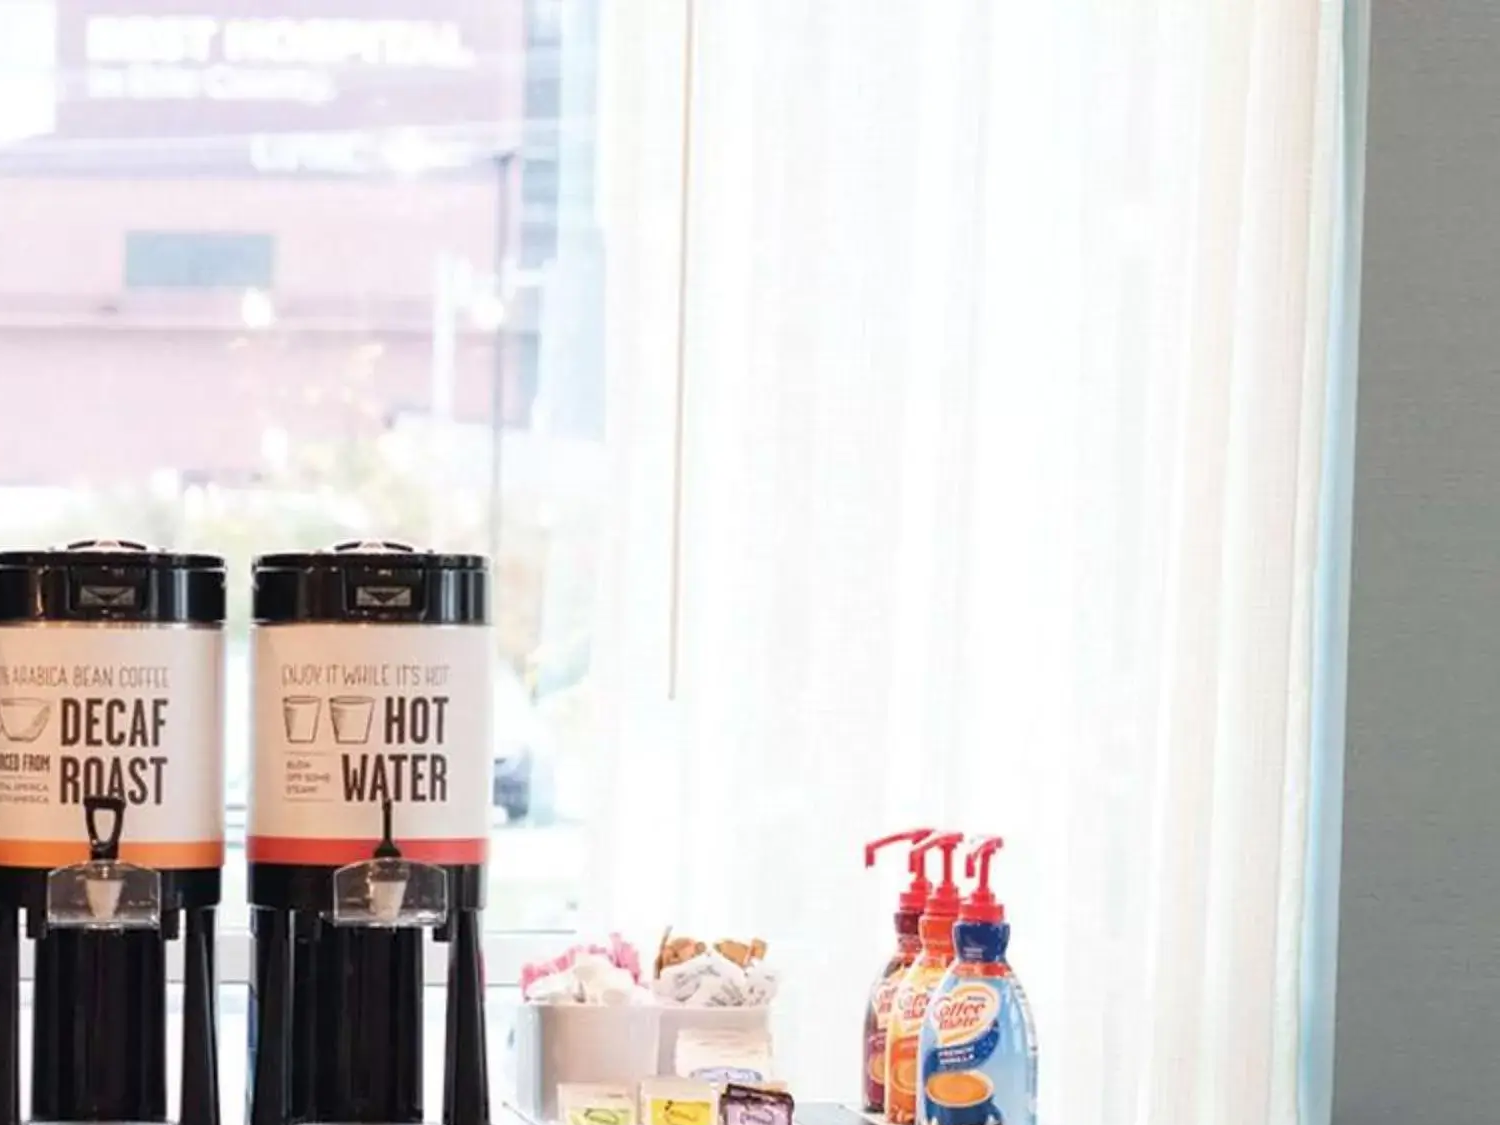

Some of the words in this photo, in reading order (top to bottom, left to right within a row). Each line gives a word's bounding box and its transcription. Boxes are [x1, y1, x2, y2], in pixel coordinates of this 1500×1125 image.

[12, 665, 68, 687] ARABICA
[73, 665, 113, 688] BEAN
[119, 667, 169, 689] COFFEE
[282, 664, 322, 686] ENJOY
[326, 664, 338, 686] IT
[341, 664, 390, 687] WHILE
[425, 665, 450, 685] HOT
[60, 698, 168, 747] DECAF
[385, 696, 449, 744] HOT
[22, 754, 50, 772] FROM
[60, 756, 168, 805] ROAST
[342, 753, 448, 803] WATER
